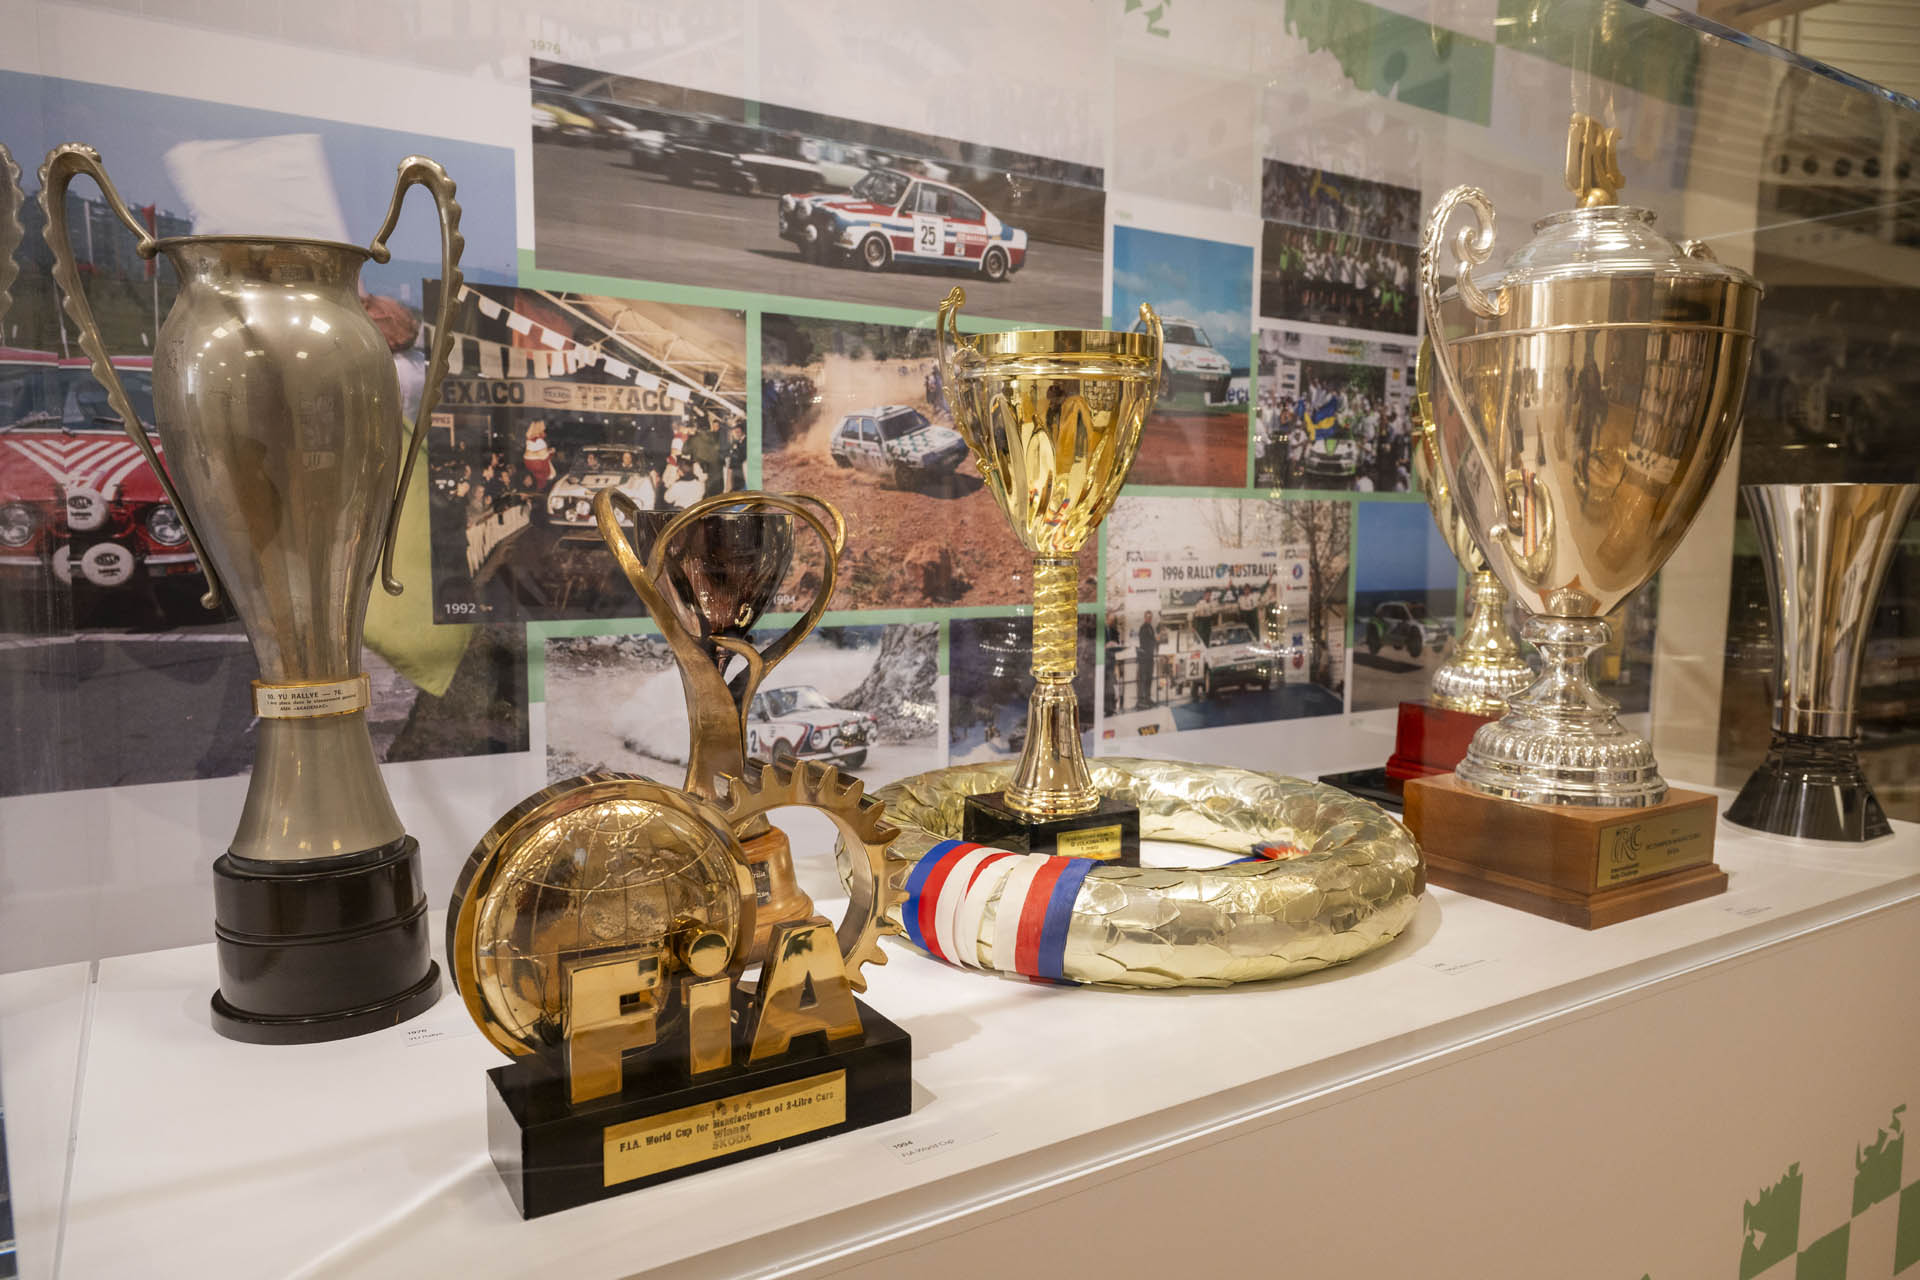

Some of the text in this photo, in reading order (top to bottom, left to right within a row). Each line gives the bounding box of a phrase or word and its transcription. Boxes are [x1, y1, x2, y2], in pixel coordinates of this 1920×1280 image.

[921, 225, 936, 246] 25
[442, 381, 525, 404] EXACO
[577, 386, 674, 411] TEXACO
[1162, 567, 1184, 580] 1996
[1187, 565, 1215, 579] RALLY
[444, 603, 477, 614] 1992
[646, 1131, 671, 1146] World
[676, 1127, 693, 1139] Cup
[697, 1122, 708, 1133] for
[775, 1101, 783, 1112] of
[816, 1090, 834, 1102] Cars
[713, 1123, 751, 1140] Winner
